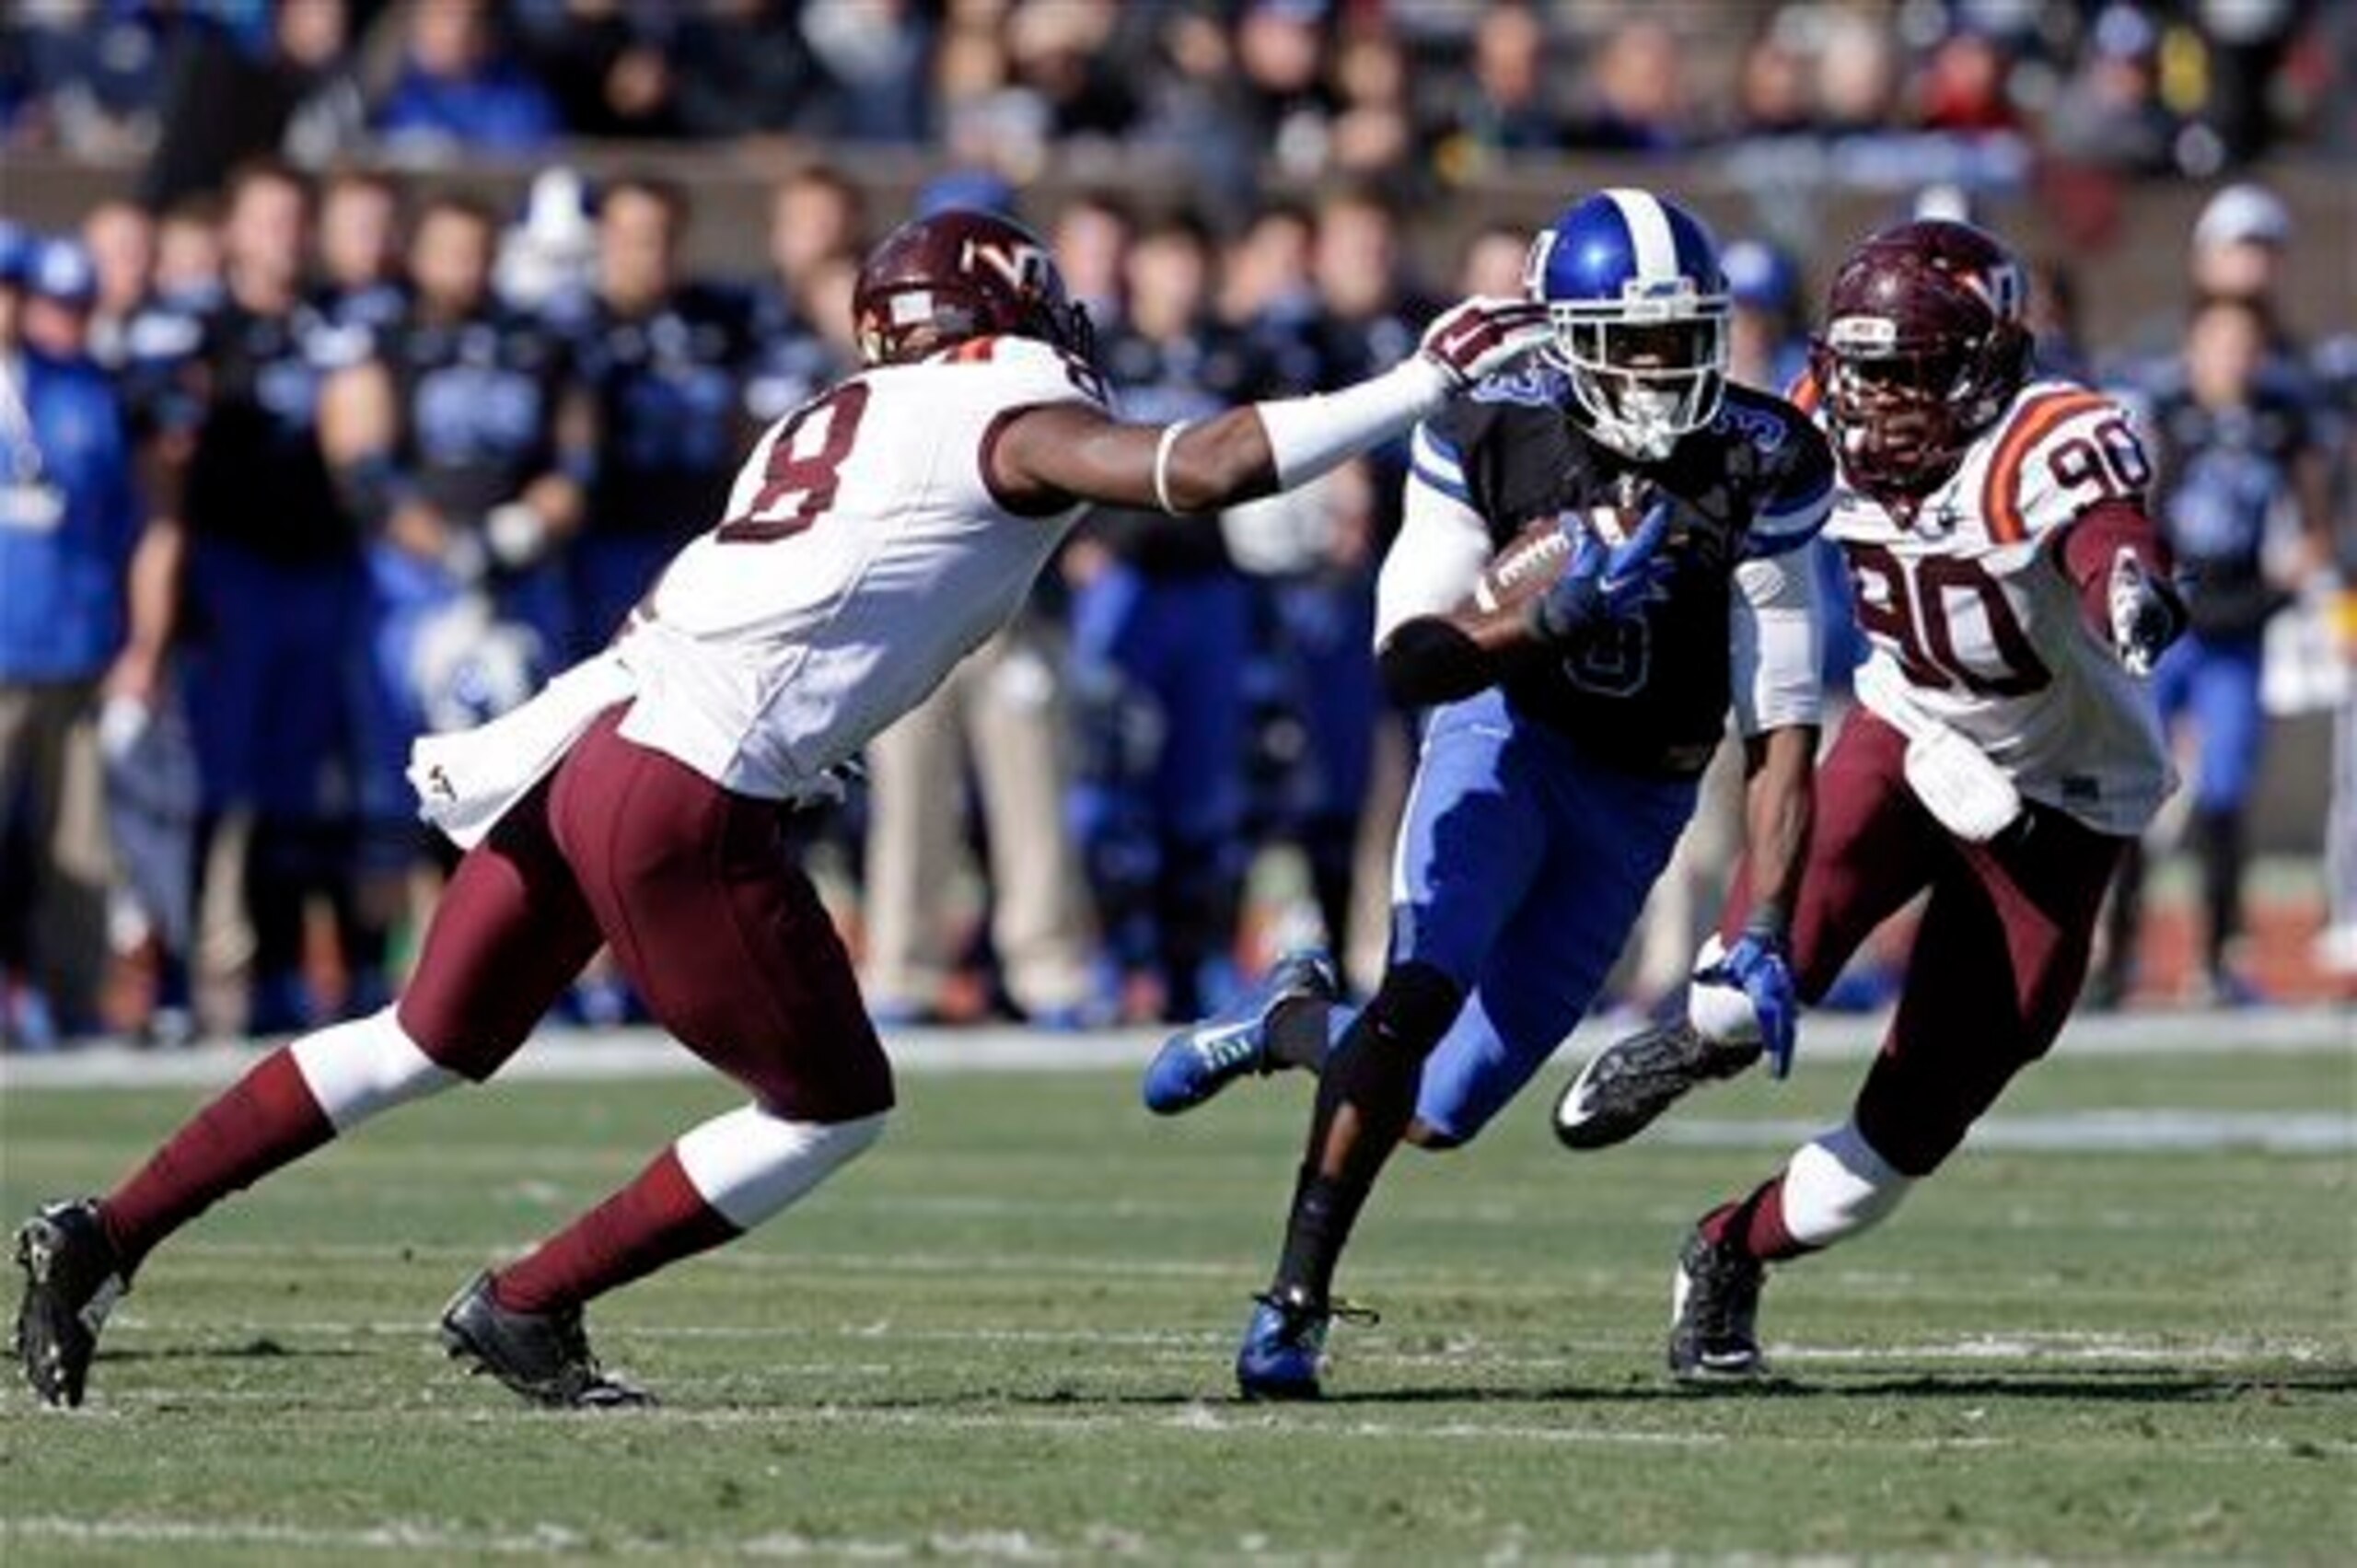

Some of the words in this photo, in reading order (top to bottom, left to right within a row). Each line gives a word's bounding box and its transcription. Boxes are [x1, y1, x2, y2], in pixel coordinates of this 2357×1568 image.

[715, 379, 870, 543] 8
[2048, 418, 2150, 497] 90
[1849, 543, 2052, 696] 90
